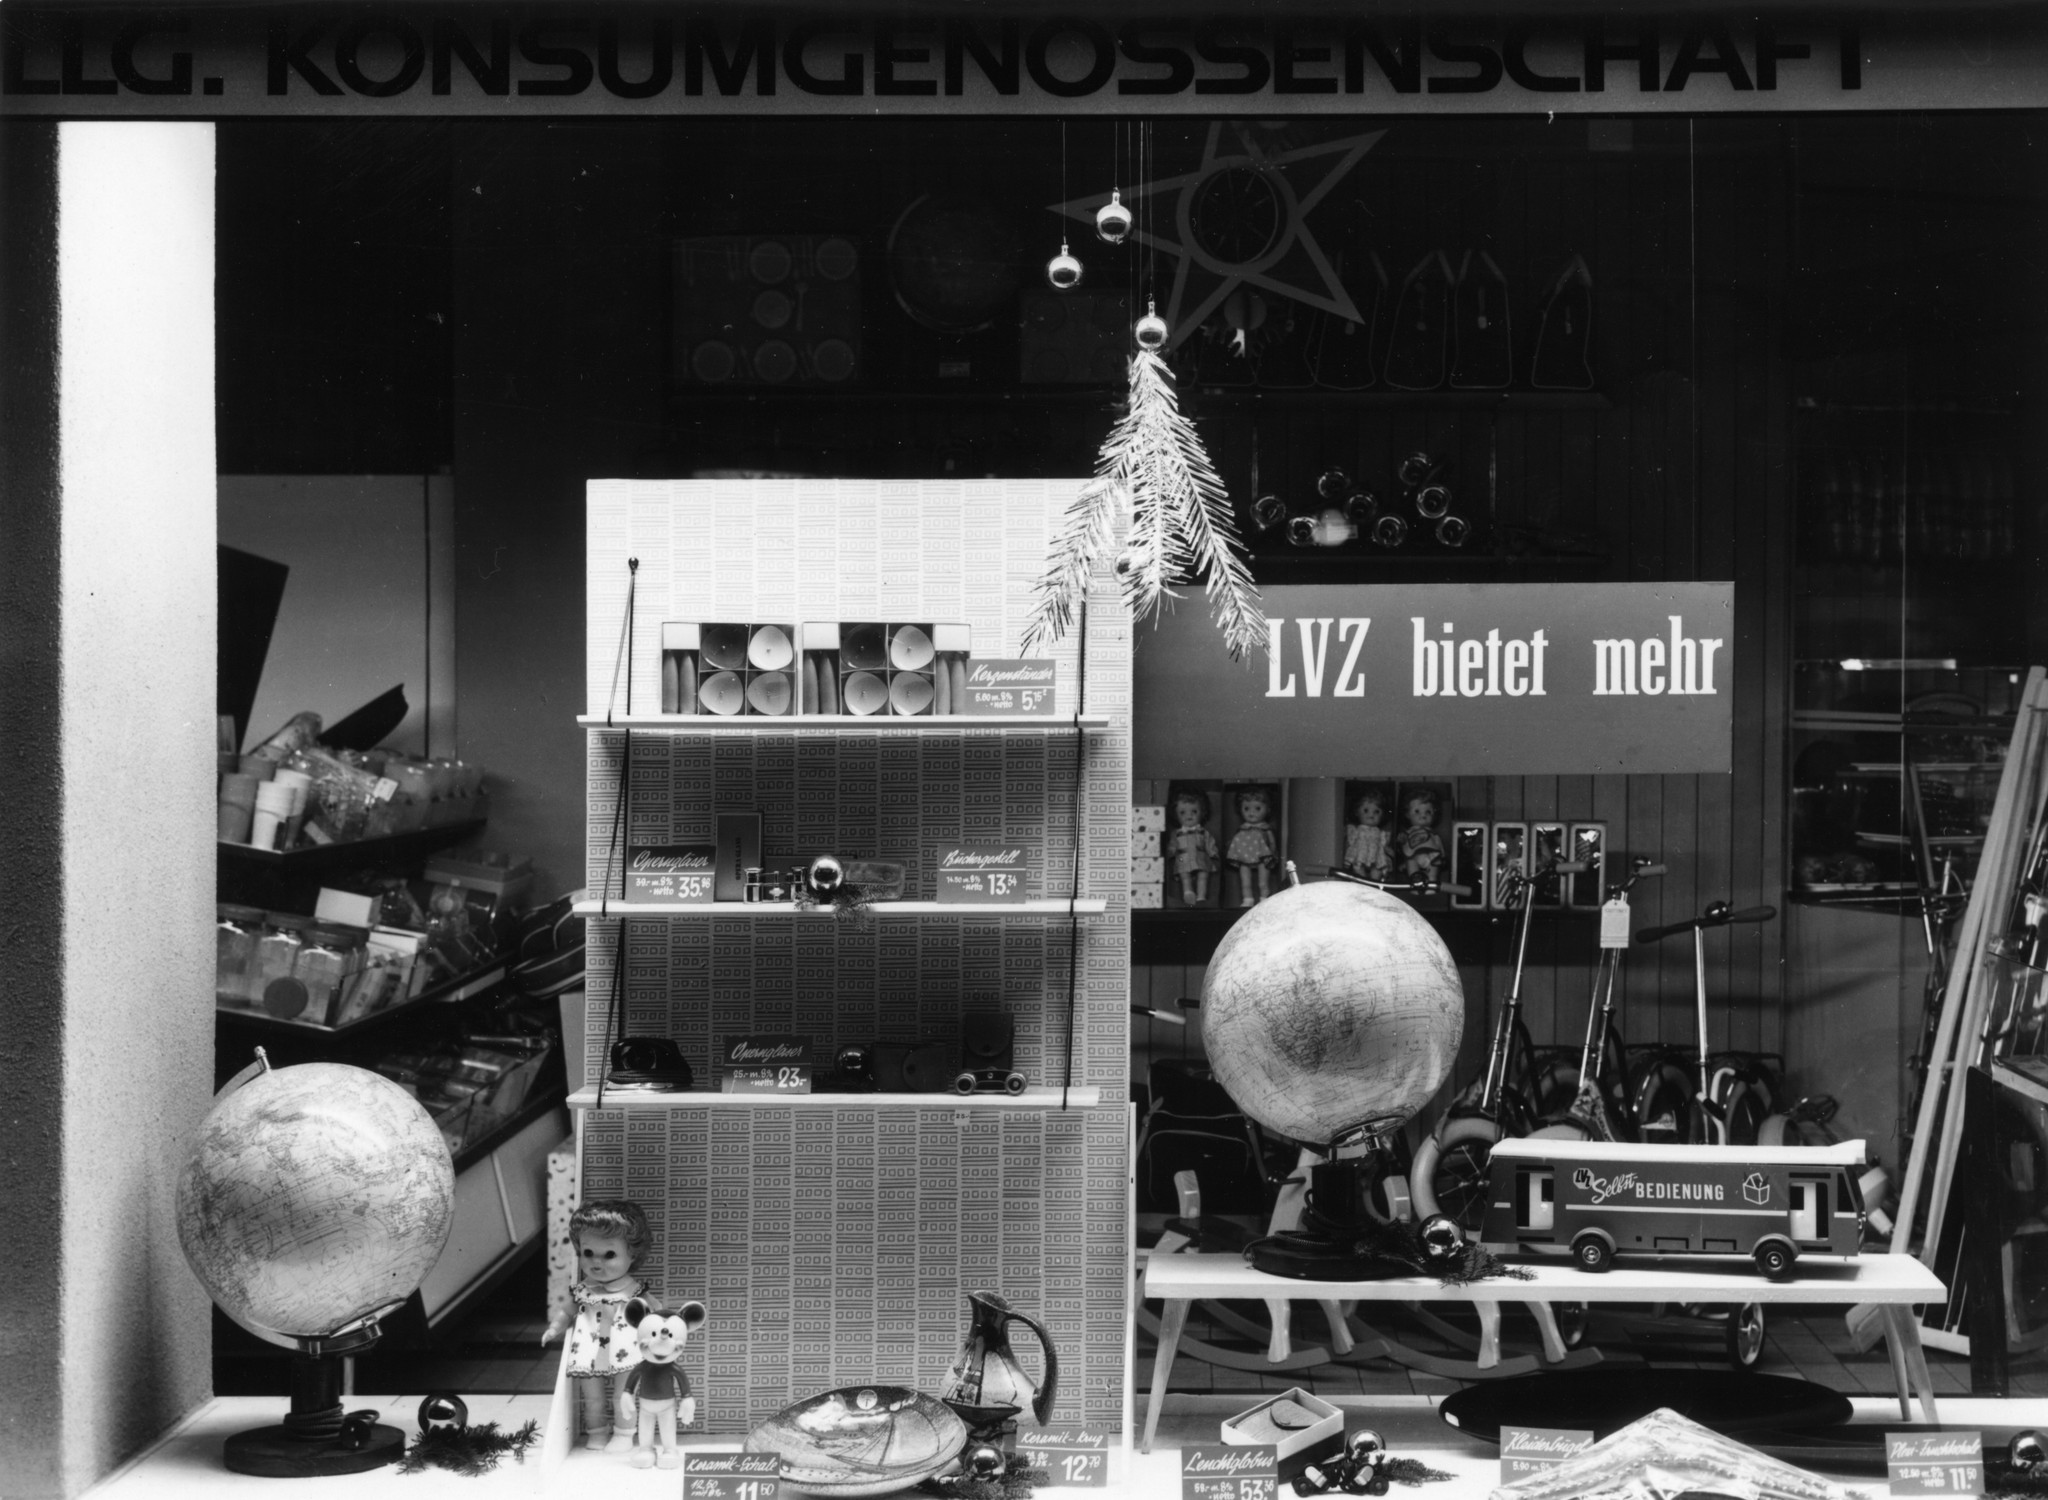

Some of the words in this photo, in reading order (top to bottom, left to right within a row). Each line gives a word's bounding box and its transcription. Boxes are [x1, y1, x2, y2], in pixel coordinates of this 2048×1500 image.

[266, 17, 1872, 99] KONSUMGENOSSENSCHAFT
[1265, 617, 1372, 698] LVZ
[1411, 616, 1549, 698] bietet
[1593, 614, 1725, 697] mehr
[1635, 1182, 1725, 1201] BEDIENUNG
[1504, 1431, 1595, 1458] Kleiderbügel
[1183, 1450, 1275, 1476] Leuchtglobus
